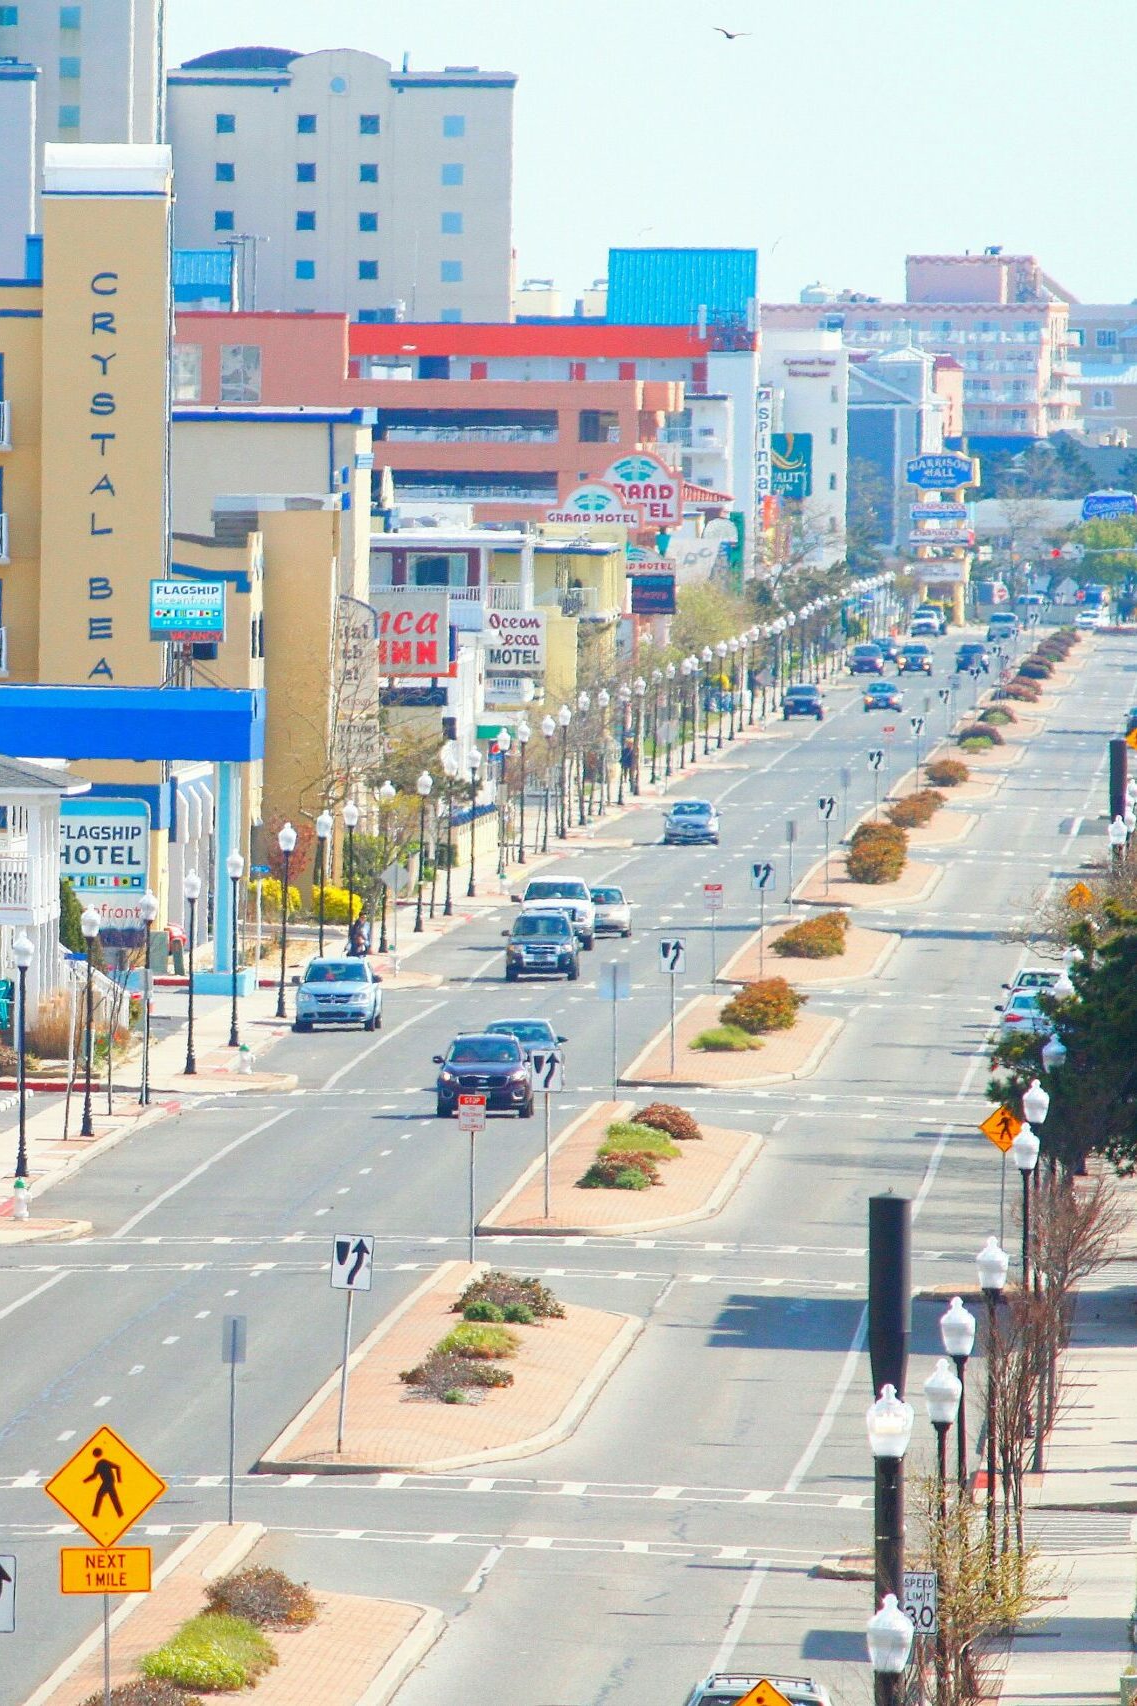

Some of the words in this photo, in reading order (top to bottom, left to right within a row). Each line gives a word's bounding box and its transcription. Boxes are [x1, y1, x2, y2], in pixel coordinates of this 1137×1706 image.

[90, 272, 118, 536] CRYSTAL
[643, 502, 673, 518] EL
[547, 513, 591, 523] GRAND
[595, 513, 637, 524] HOTEL
[639, 563, 673, 571] HOTEL
[156, 586, 220, 595] FLAGSHIP
[88, 577, 113, 680] BEA
[489, 613, 541, 630] Ocean
[499, 633, 540, 647] ecca
[490, 649, 541, 665] MOTEL
[60, 845, 141, 865] HOTEL
[85, 1554, 126, 1569] NEXT
[86, 1572, 92, 1587] 1
[96, 1572, 128, 1587] MILE
[904, 1578, 934, 1588] SPEED
[905, 1605, 934, 1628] 30
